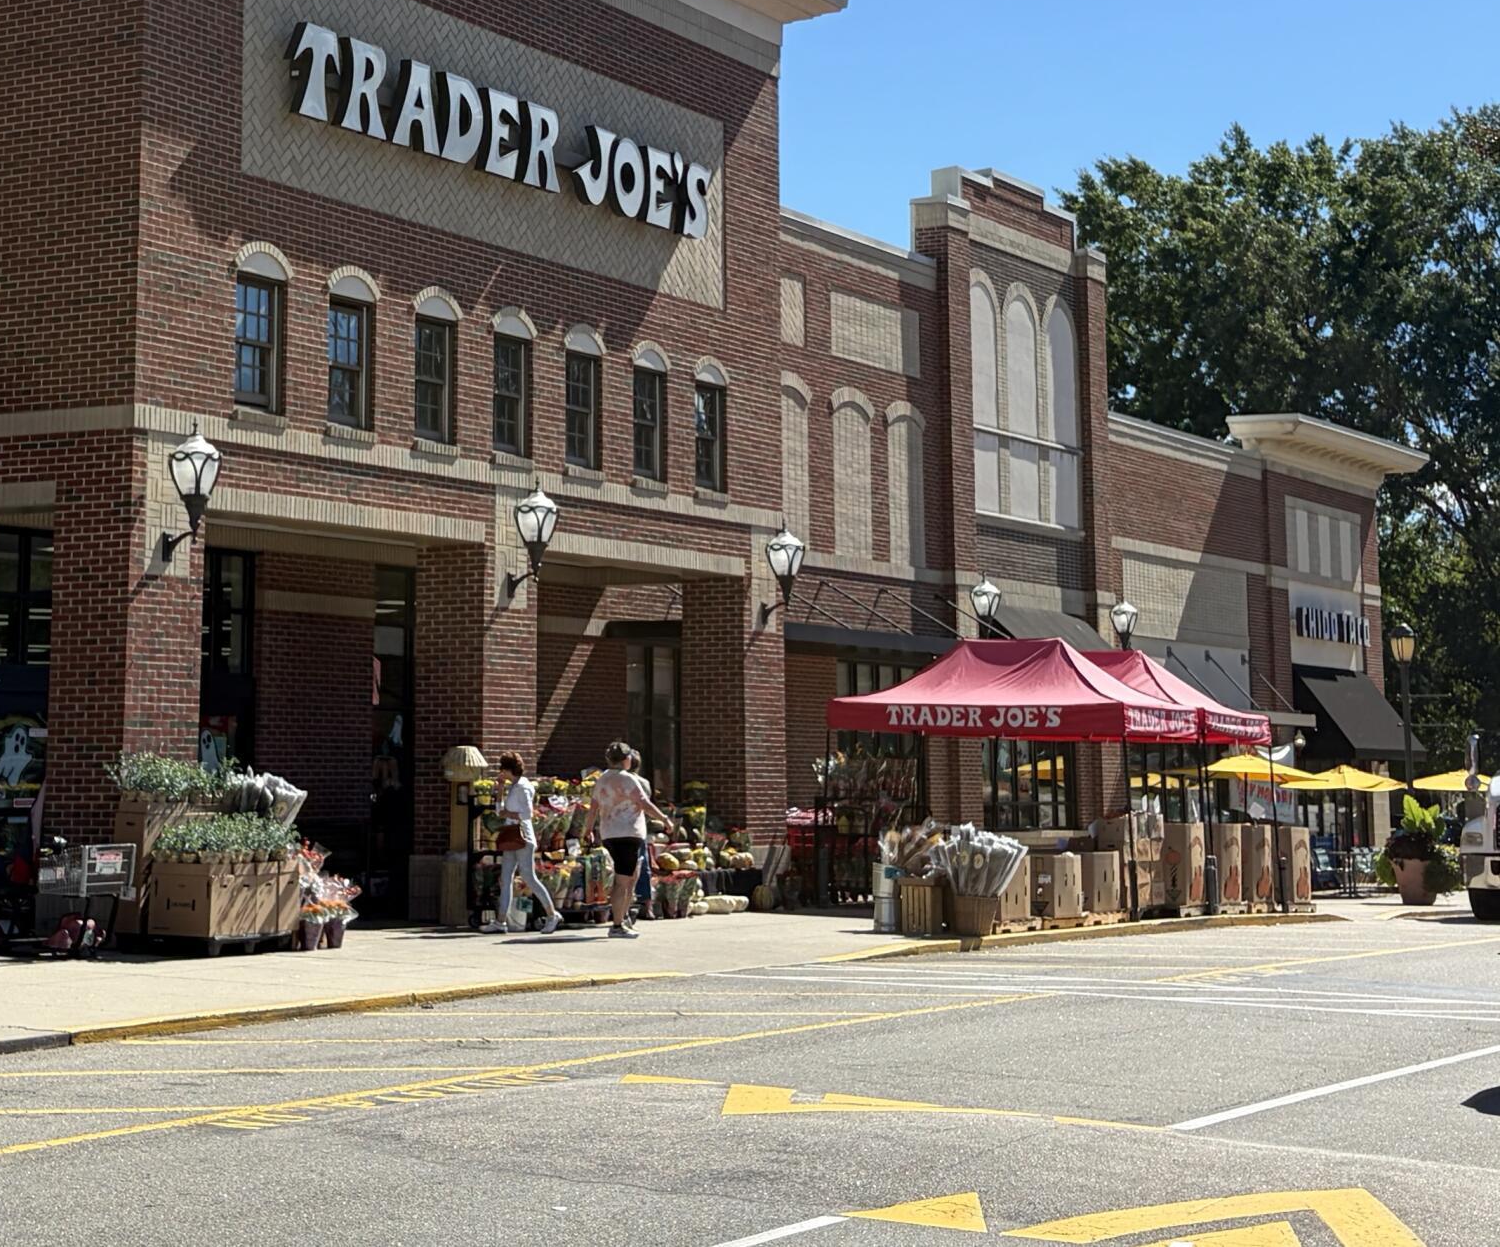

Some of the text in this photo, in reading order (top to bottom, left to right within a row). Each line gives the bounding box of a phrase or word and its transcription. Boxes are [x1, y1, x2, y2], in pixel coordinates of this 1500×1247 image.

[288, 21, 712, 240] TRADER JOE'S
[1297, 607, 1338, 641] CHIDO
[886, 705, 1062, 728] TRADER JOE'S
